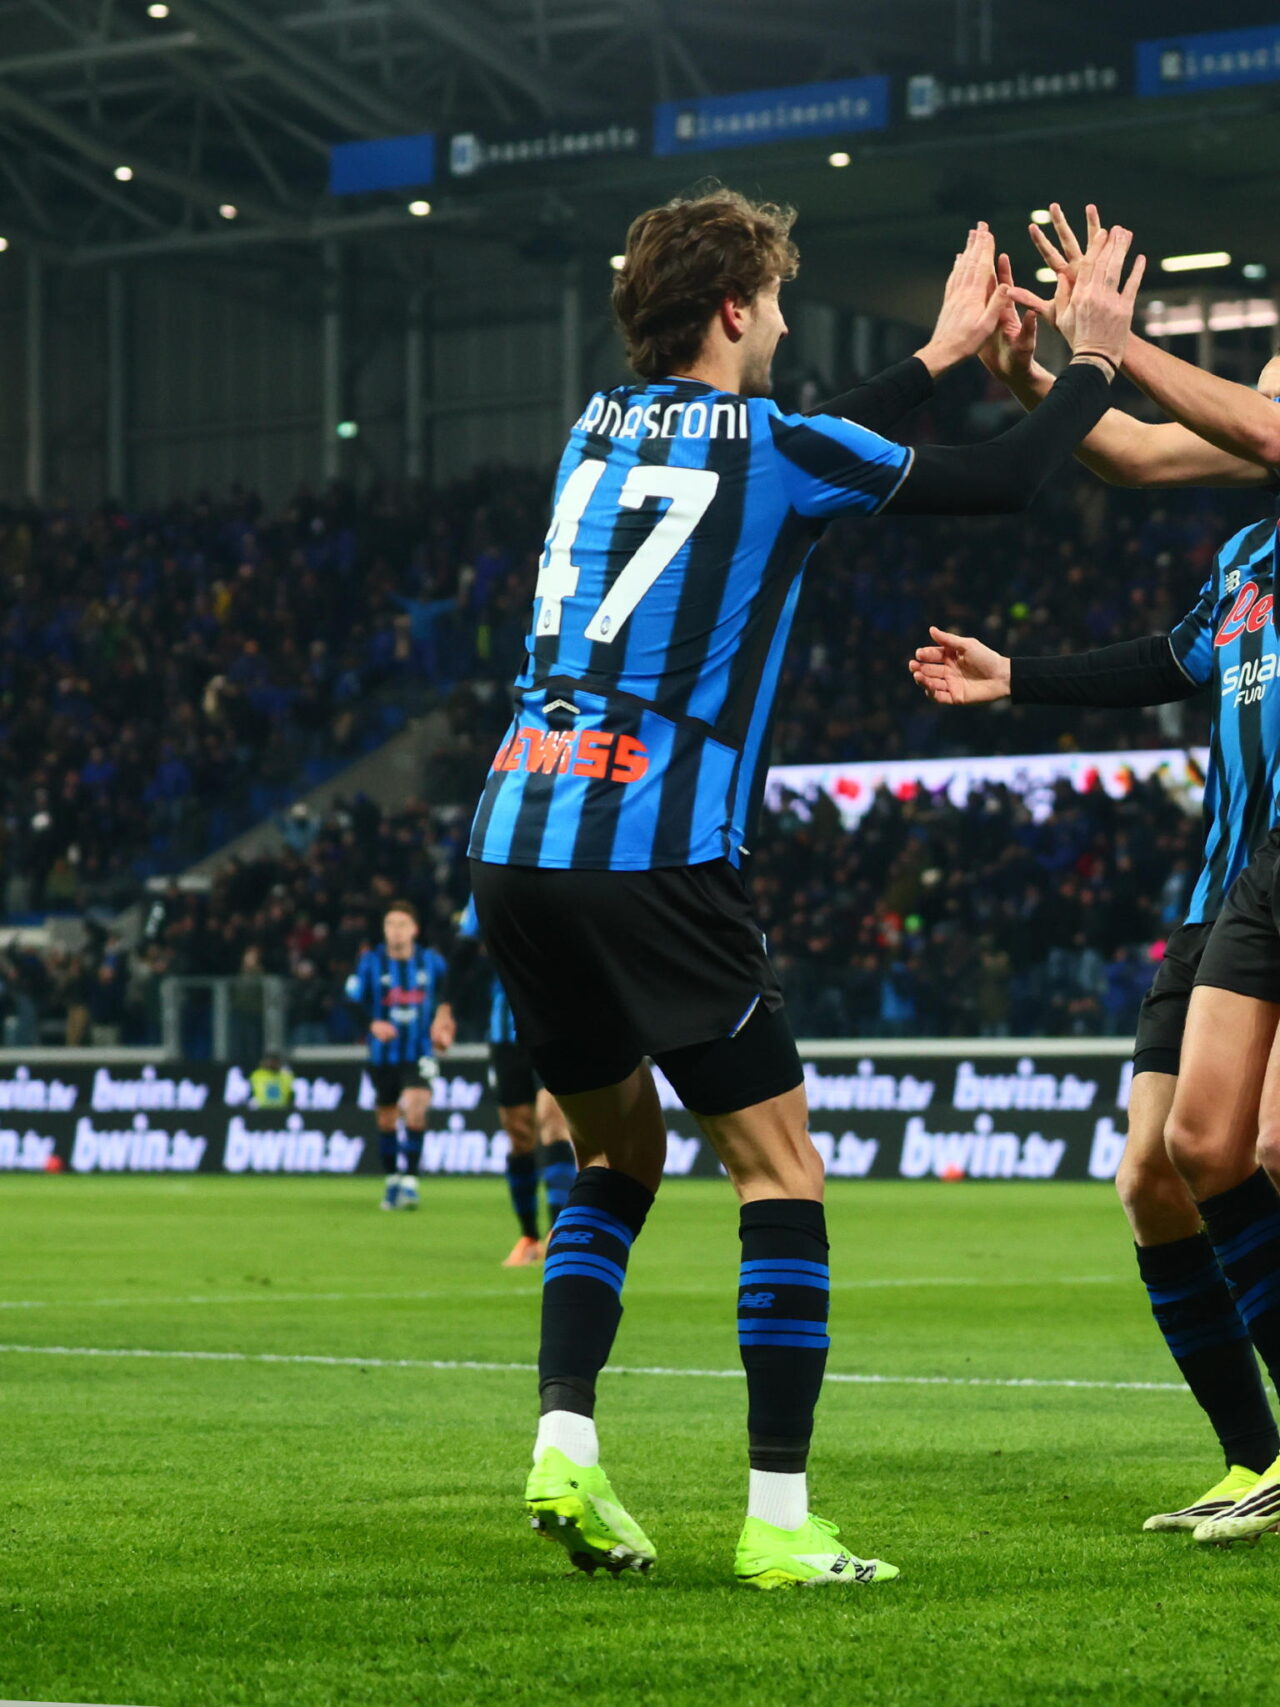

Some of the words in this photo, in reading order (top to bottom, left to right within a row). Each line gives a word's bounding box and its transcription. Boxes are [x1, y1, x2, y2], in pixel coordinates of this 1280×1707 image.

[573, 396, 748, 440] RNASCONI
[535, 458, 720, 643] 47
[1213, 581, 1276, 648] Le
[0, 1065, 78, 1112] in.tv
[91, 1065, 208, 1112] bwin.tv
[224, 1066, 342, 1110] bn.tv
[953, 1057, 1098, 1111] bwin.tv
[71, 1112, 208, 1172] bwin.tv
[223, 1113, 365, 1173] bwin.tv
[899, 1113, 1066, 1179] bwin.tv
